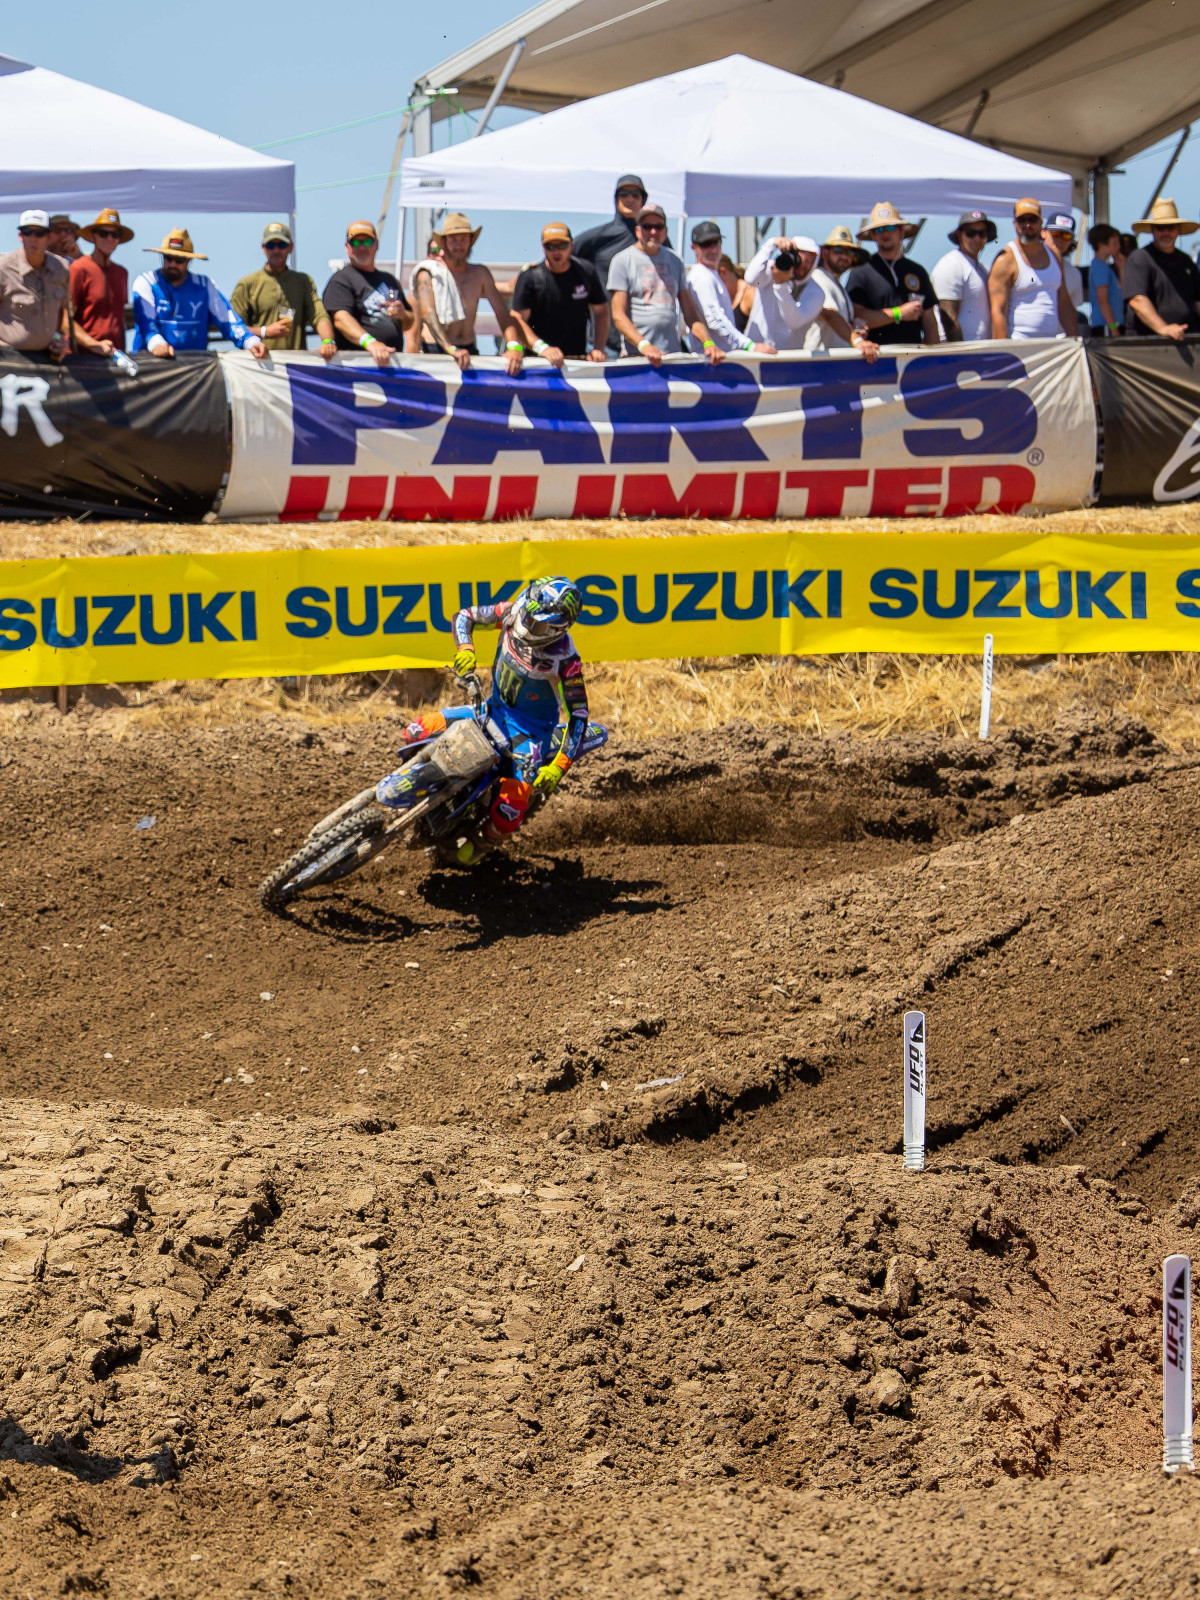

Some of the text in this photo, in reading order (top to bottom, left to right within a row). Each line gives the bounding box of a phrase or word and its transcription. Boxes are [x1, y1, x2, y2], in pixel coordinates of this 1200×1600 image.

[157, 300, 202, 318] FLY
[286, 354, 1038, 465] PARTS
[574, 570, 842, 625] SUZUKI
[869, 569, 1147, 619] SUZUKI
[909, 1043, 921, 1094] UFO
[1166, 1302, 1180, 1369] UFO
